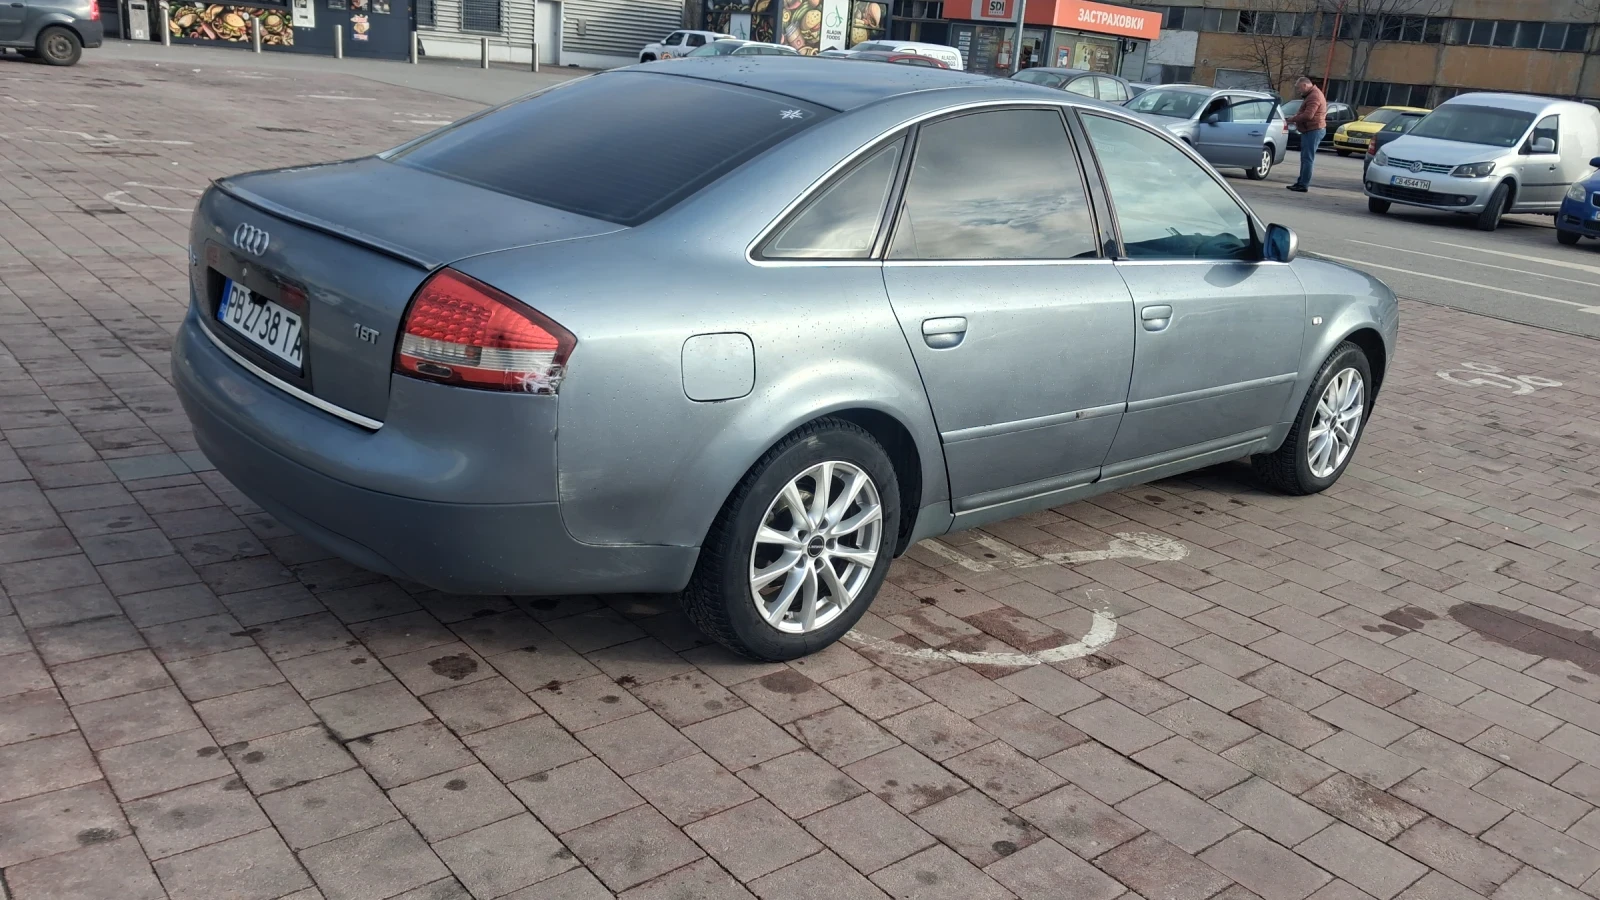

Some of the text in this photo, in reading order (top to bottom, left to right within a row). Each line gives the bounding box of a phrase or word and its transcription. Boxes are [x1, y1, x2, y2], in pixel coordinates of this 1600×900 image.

[990, 1, 1005, 12] SDI
[1077, 8, 1145, 31] ЗАСТРАХОВКИ
[226, 285, 302, 361] PB 2738 TA
